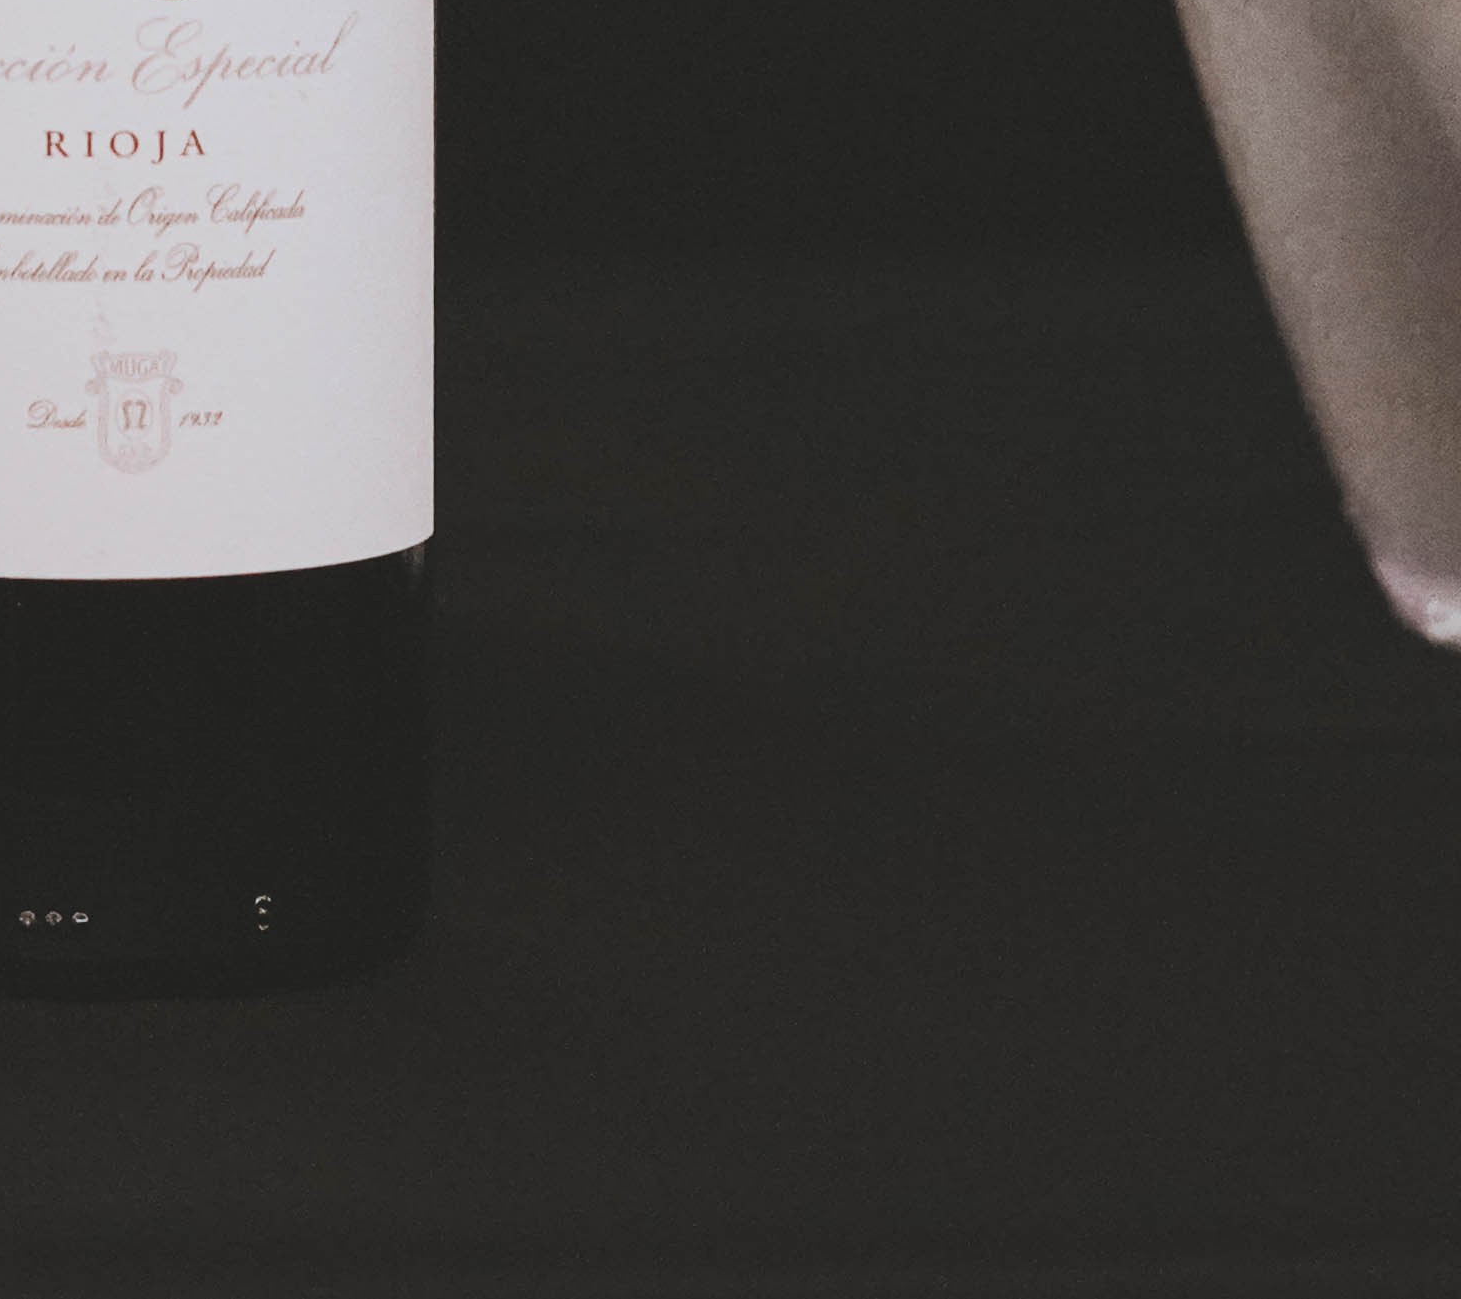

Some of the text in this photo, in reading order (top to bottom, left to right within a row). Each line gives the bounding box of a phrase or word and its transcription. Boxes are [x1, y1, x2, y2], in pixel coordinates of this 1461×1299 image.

[131, 9, 359, 109] Especial
[43, 128, 207, 166] RIOJA
[97, 197, 123, 227] de
[127, 184, 199, 239] Origen
[102, 266, 128, 284] en
[134, 248, 156, 284] la
